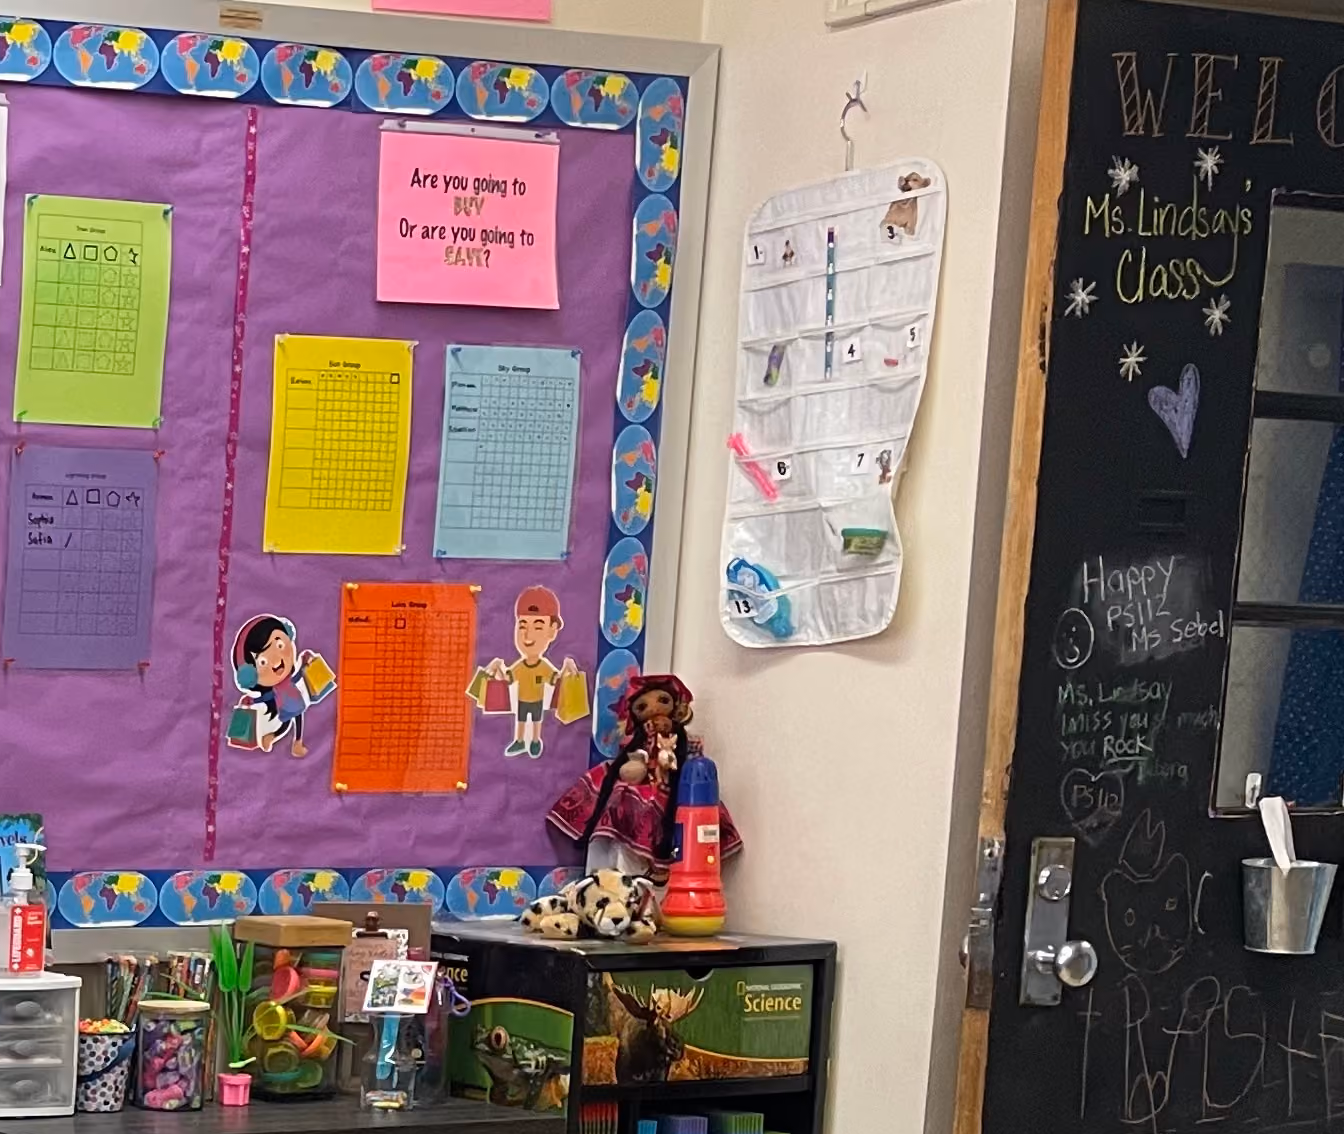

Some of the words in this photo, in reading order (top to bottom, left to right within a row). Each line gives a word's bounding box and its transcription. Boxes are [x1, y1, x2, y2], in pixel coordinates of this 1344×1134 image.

[410, 167, 438, 189] Are
[443, 174, 468, 193] you
[473, 173, 507, 197] going
[512, 177, 526, 195] to
[1084, 193, 1132, 238] Ms.
[399, 217, 417, 239] Or
[421, 224, 446, 240] are
[451, 225, 476, 244] you
[480, 226, 514, 248] going
[519, 229, 534, 246] to
[847, 343, 856, 358] 4
[1082, 555, 1178, 603] Happy
[734, 600, 751, 614] 13
[1132, 627, 1161, 652] Ms
[743, 993, 802, 1013] Science
